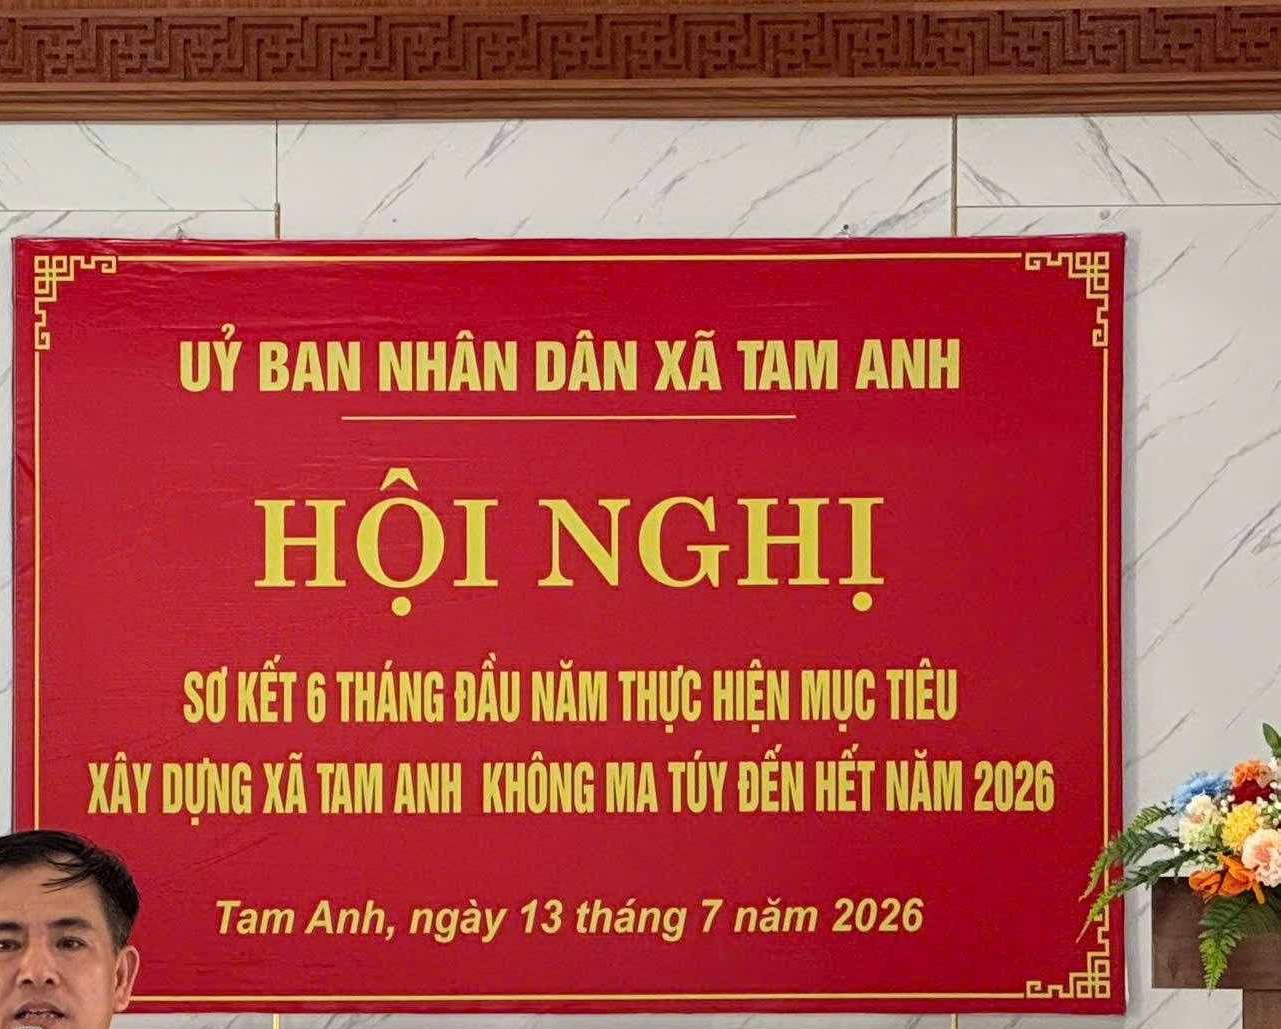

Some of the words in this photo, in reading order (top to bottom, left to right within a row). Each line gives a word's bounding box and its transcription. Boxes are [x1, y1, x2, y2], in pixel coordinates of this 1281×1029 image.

[180, 324, 241, 392] UỶ
[260, 341, 360, 391] BAN
[379, 330, 517, 391] NHÂN
[536, 330, 637, 391] DÂN
[655, 331, 720, 390] XÃ
[737, 340, 837, 390] TAM
[856, 339, 959, 389] ANH
[255, 468, 498, 616] HỘI
[539, 497, 884, 611] NGHỊ
[184, 667, 227, 723] SƠ
[238, 656, 297, 722] KẾT
[307, 672, 326, 722] 6
[336, 661, 444, 722] THÁNG
[454, 652, 520, 722] ĐẦU
[532, 661, 607, 721] NĂM
[618, 666, 701, 733] THỰC
[714, 659, 789, 732] HIỆN
[802, 669, 875, 732] MỤC
[886, 658, 957, 720] TIÊU
[89, 752, 151, 813] XÂY
[163, 758, 251, 825] DỰNG
[264, 753, 306, 813] XÃ
[317, 763, 383, 813] TAM
[394, 763, 461, 813] ANH
[483, 752, 594, 813] KHÔNG
[606, 762, 657, 812] MA
[668, 752, 727, 812] TÚY
[738, 746, 803, 812] ĐẾN
[816, 746, 875, 811] HẾT
[886, 751, 962, 811] NĂM
[974, 761, 1054, 811] 2026
[215, 901, 294, 933] Tam
[306, 900, 394, 938] Anh,
[410, 907, 506, 943] ngày
[521, 900, 563, 933] 13
[576, 899, 686, 942] tháng
[701, 899, 722, 931] 7
[734, 905, 817, 932] năm
[832, 898, 923, 931] 2026
